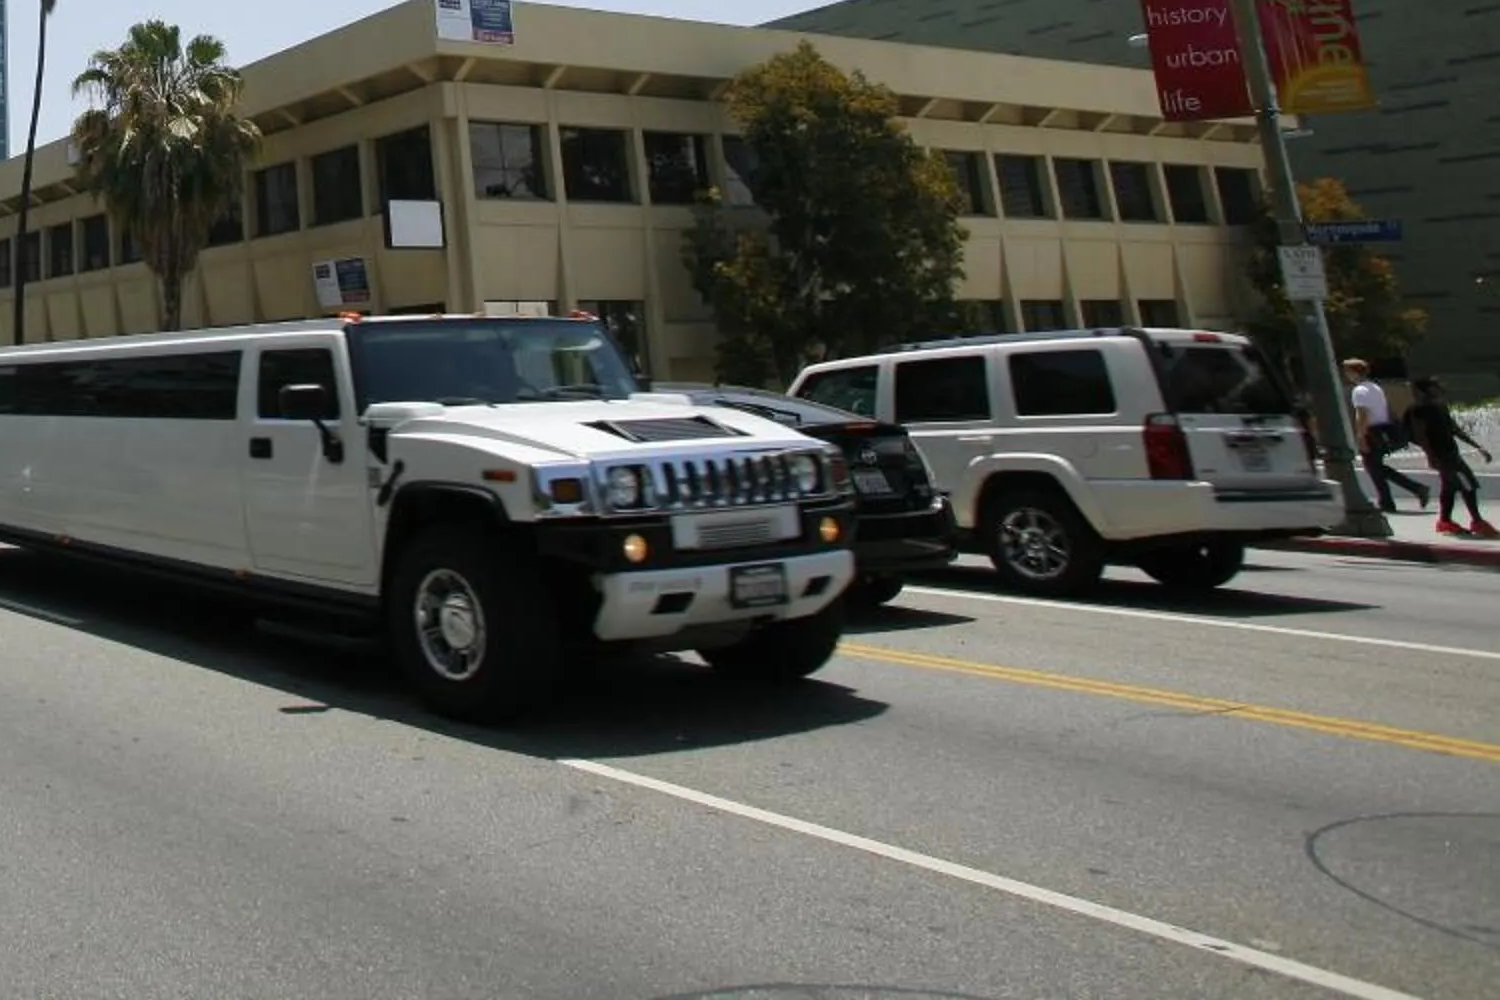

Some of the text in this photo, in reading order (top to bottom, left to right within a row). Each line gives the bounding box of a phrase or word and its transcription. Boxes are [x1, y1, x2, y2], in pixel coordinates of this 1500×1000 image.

[1145, 4, 1228, 28] history
[1165, 44, 1239, 68] urban
[1162, 88, 1201, 114] life
